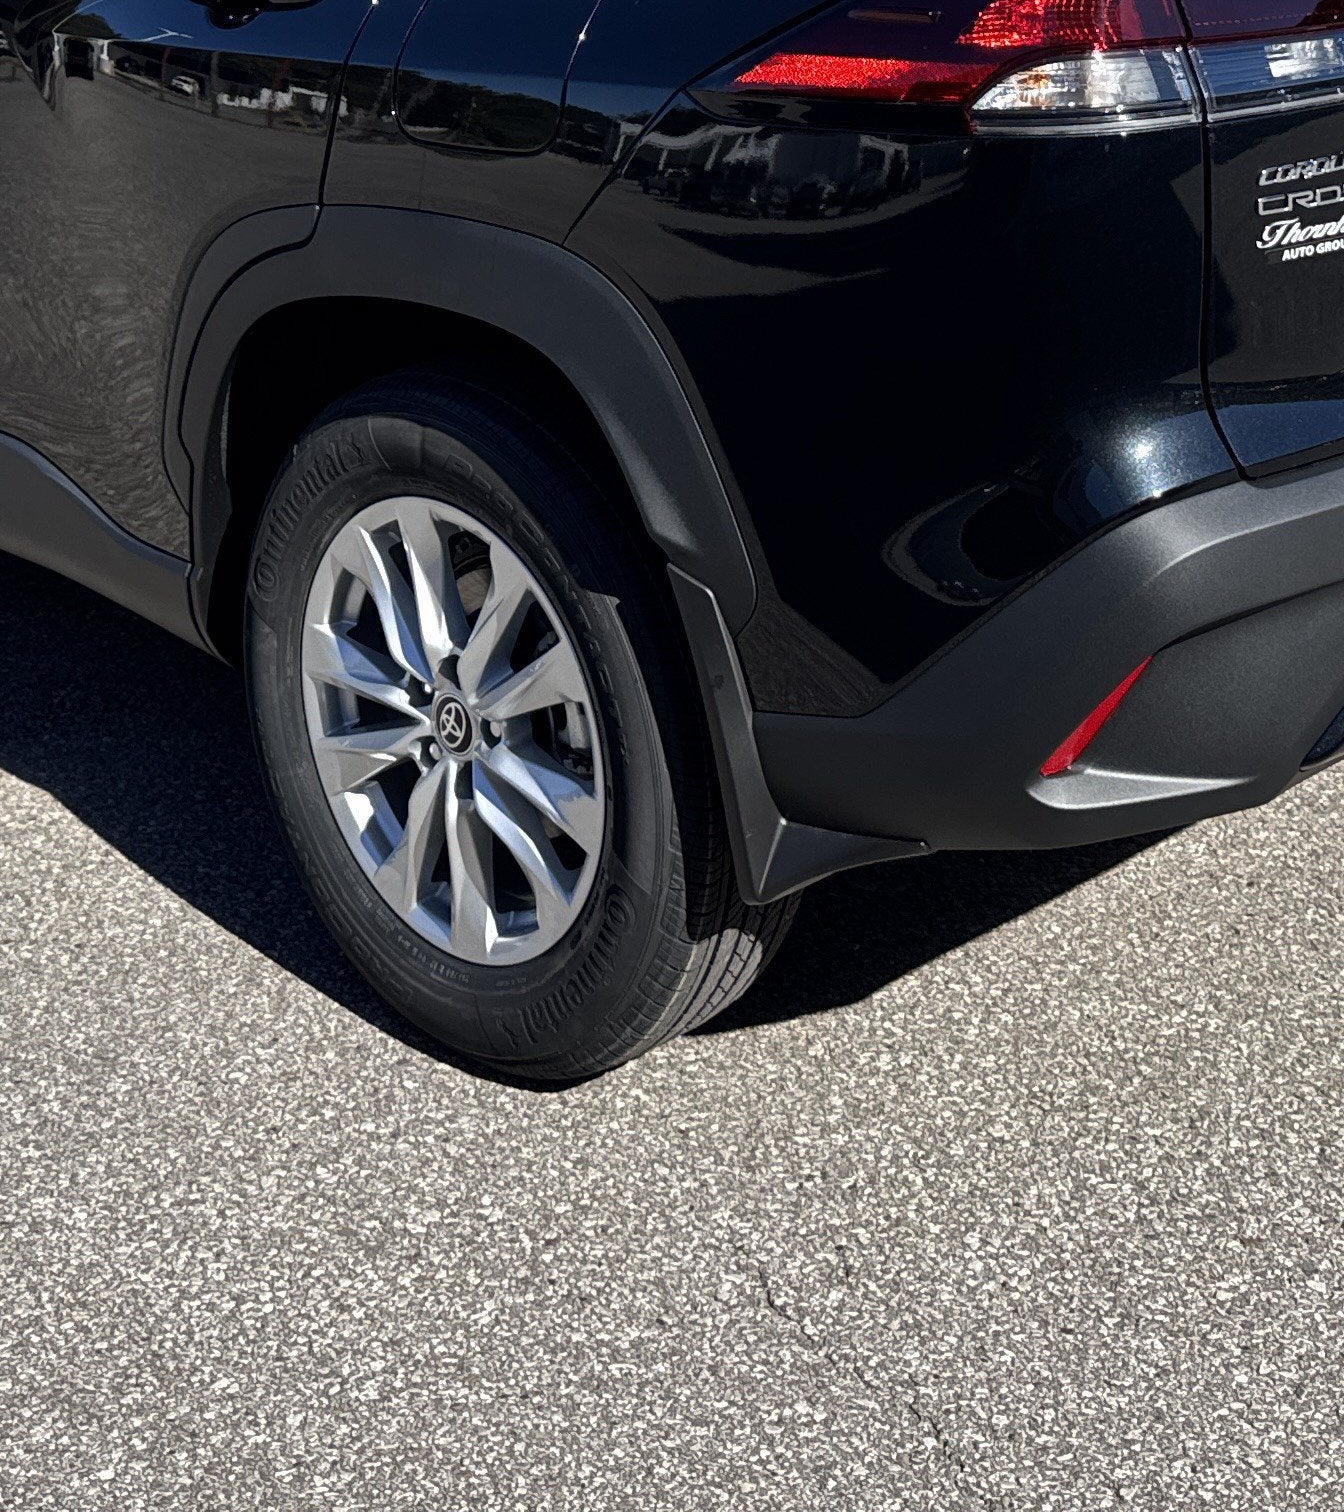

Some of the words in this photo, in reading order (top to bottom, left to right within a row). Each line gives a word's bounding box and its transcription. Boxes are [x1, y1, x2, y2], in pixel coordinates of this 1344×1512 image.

[1282, 242, 1315, 262] AUTO
[253, 442, 349, 601] Continental
[519, 884, 636, 1045] Continental
